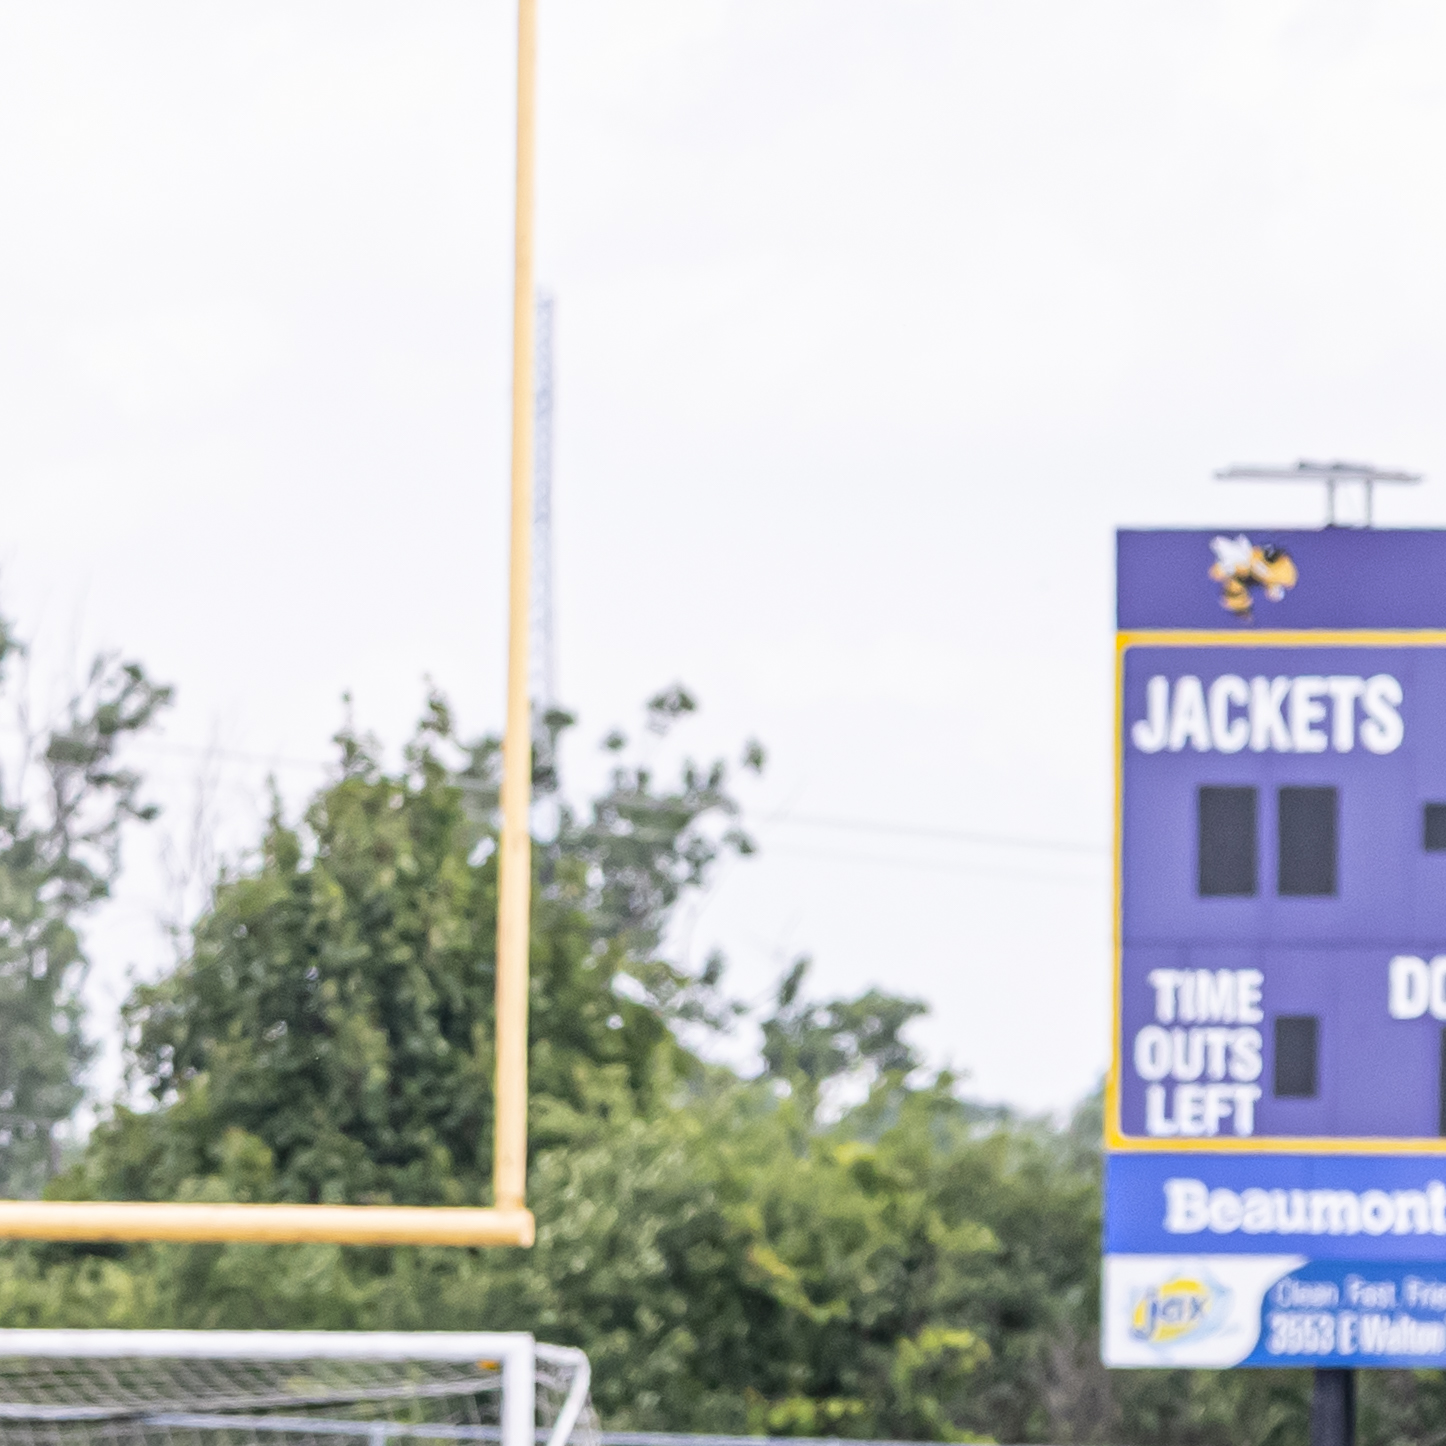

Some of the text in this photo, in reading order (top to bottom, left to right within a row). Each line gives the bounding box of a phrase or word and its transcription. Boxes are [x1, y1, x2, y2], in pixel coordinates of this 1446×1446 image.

[1131, 674, 1404, 754] JACKETS
[1148, 969, 1264, 1023] TIME
[1135, 1029, 1264, 1082] OUTS
[1146, 1085, 1261, 1139] LEFT
[1360, 1312, 1446, 1356] Walton
